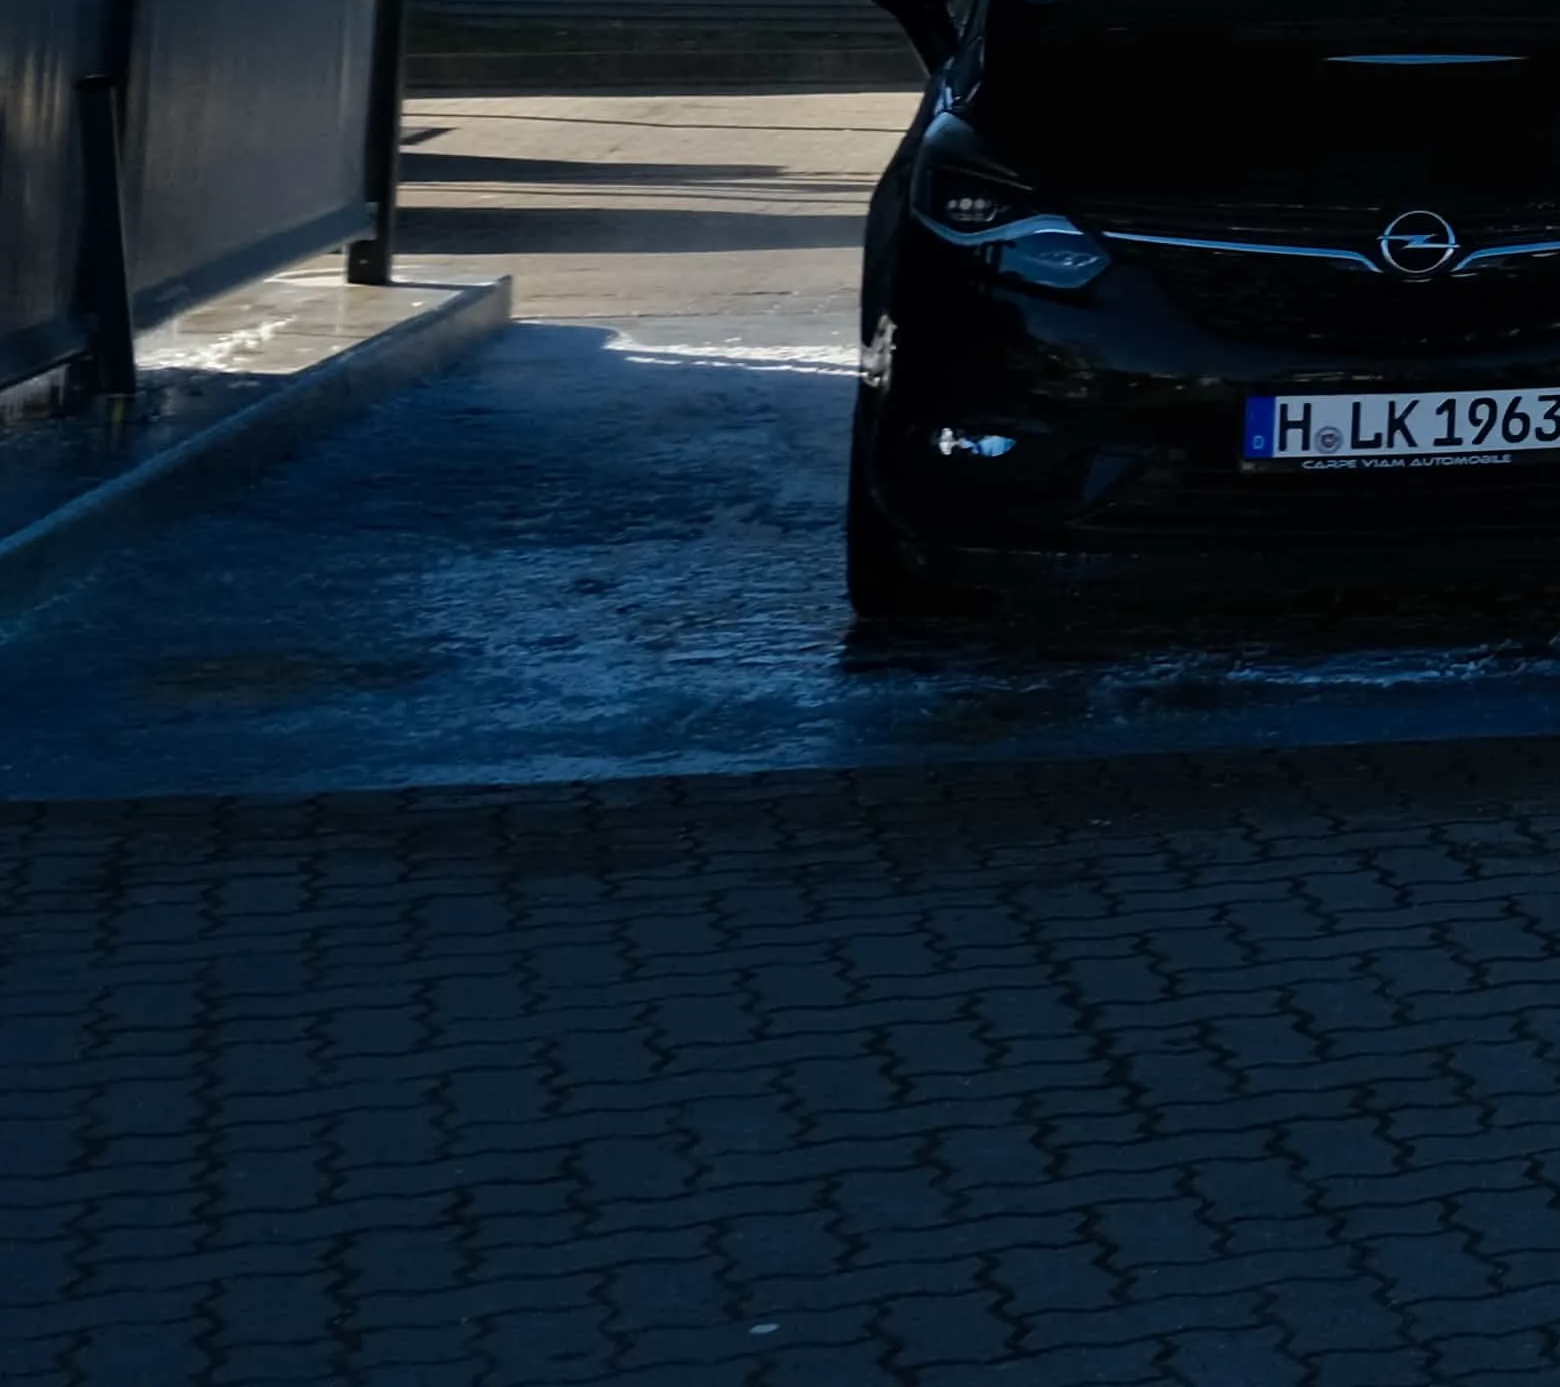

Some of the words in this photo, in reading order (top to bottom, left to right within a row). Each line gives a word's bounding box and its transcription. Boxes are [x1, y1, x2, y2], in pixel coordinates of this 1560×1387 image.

[1279, 403, 1310, 451] H
[1351, 399, 1420, 450] LK
[1302, 459, 1357, 470] CARPE
[1361, 457, 1406, 468] VIAM
[1408, 454, 1513, 467] AUTOMOBILE
